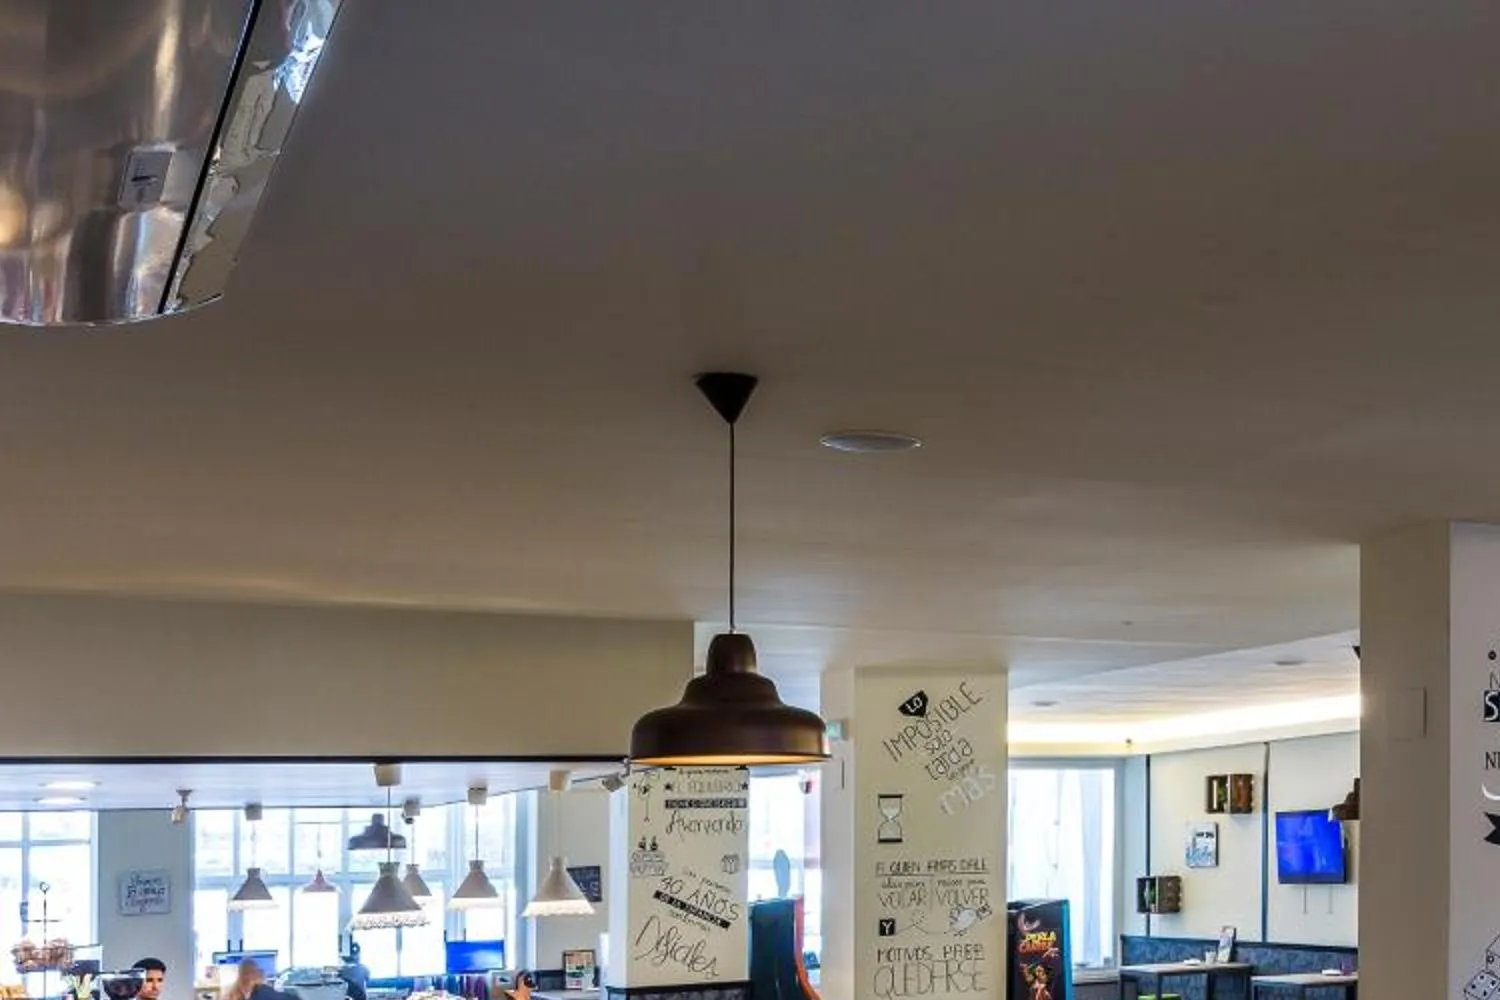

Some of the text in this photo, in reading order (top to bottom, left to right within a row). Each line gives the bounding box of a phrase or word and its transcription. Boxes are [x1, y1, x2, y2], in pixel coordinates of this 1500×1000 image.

[906, 696, 924, 713] LO
[882, 681, 985, 763] IMPOSIBLE
[882, 921, 894, 936] Y
